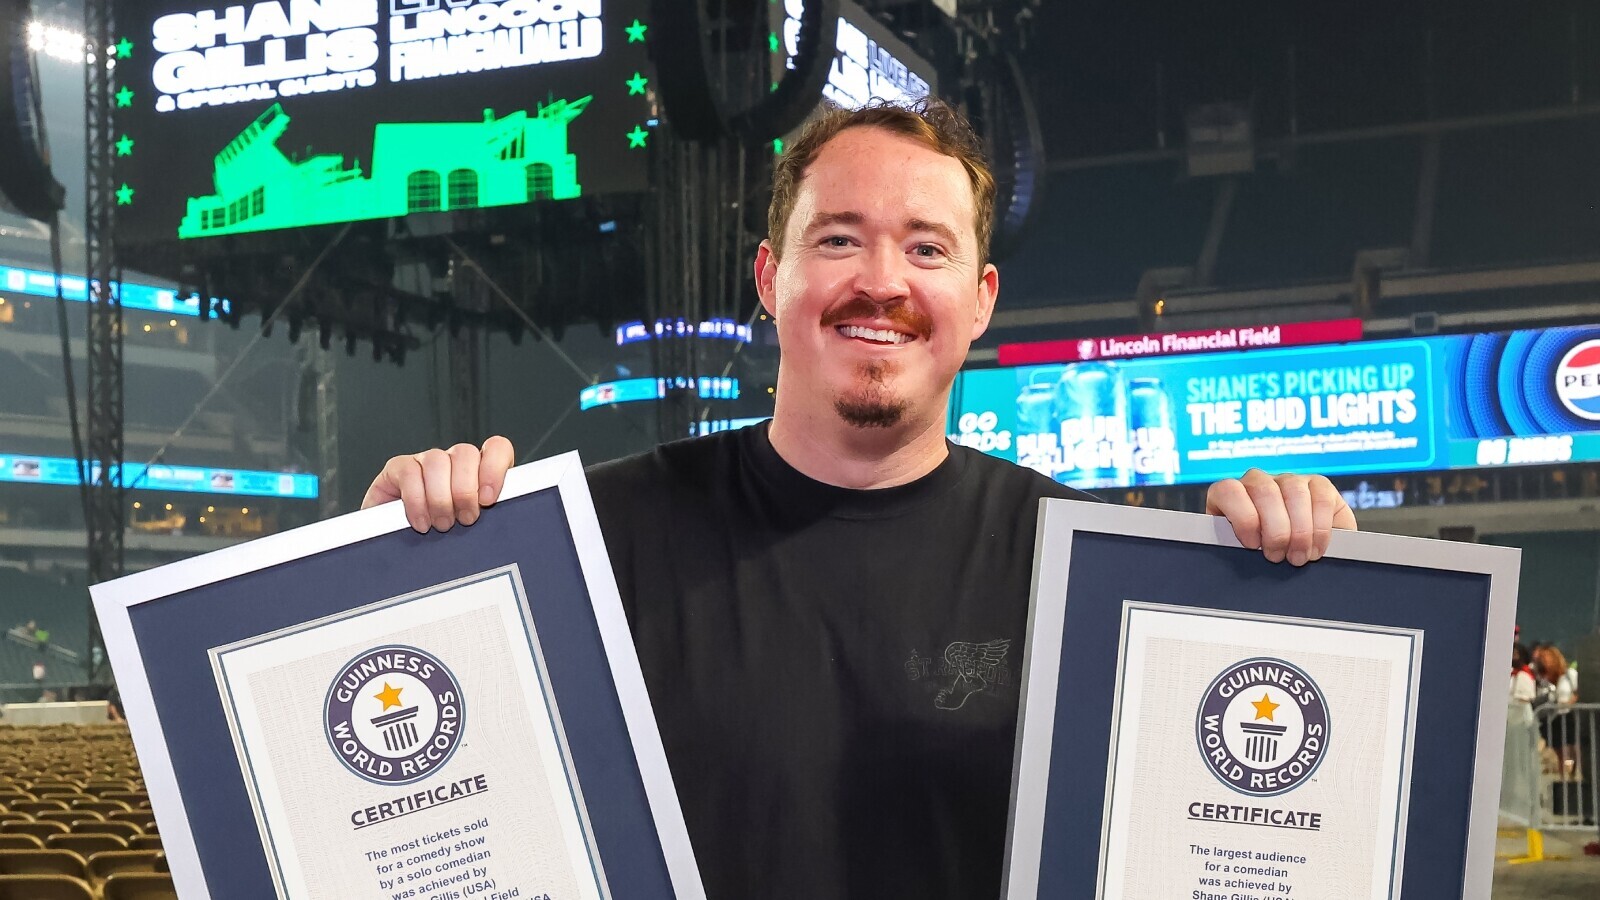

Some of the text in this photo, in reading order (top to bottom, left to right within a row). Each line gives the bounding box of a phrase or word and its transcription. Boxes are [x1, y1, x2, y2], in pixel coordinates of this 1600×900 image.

[152, 0, 379, 53] SHANE
[152, 27, 379, 94] GILLIS
[1100, 325, 1281, 357] Lincoln Financial Field
[1186, 363, 1415, 402] SHANE'S PICKING UP
[1564, 374, 1600, 387] PE
[1186, 388, 1417, 435] THE BUD LIGHTS
[336, 653, 436, 703] GUINNESS
[1218, 666, 1315, 706] GUINNESS
[333, 690, 458, 777] WORLD RECORDS
[1204, 714, 1323, 788] WORLD RECORDS
[350, 774, 489, 827] CERTIFICATE
[1188, 802, 1322, 828] CERTIFICATE
[365, 817, 489, 862] The most tickets sold
[376, 836, 486, 875] for a comedy show
[1190, 844, 1307, 864] The largest audience
[379, 850, 492, 890] by a solo comedian
[392, 866, 488, 900] was achieved by
[463, 878, 497, 898] (USA)
[1198, 877, 1292, 894] was achieved by
[1205, 861, 1221, 871] for
[1233, 866, 1288, 877] comedian
[491, 887, 520, 900] Field
[1192, 890, 1228, 900] Shane
